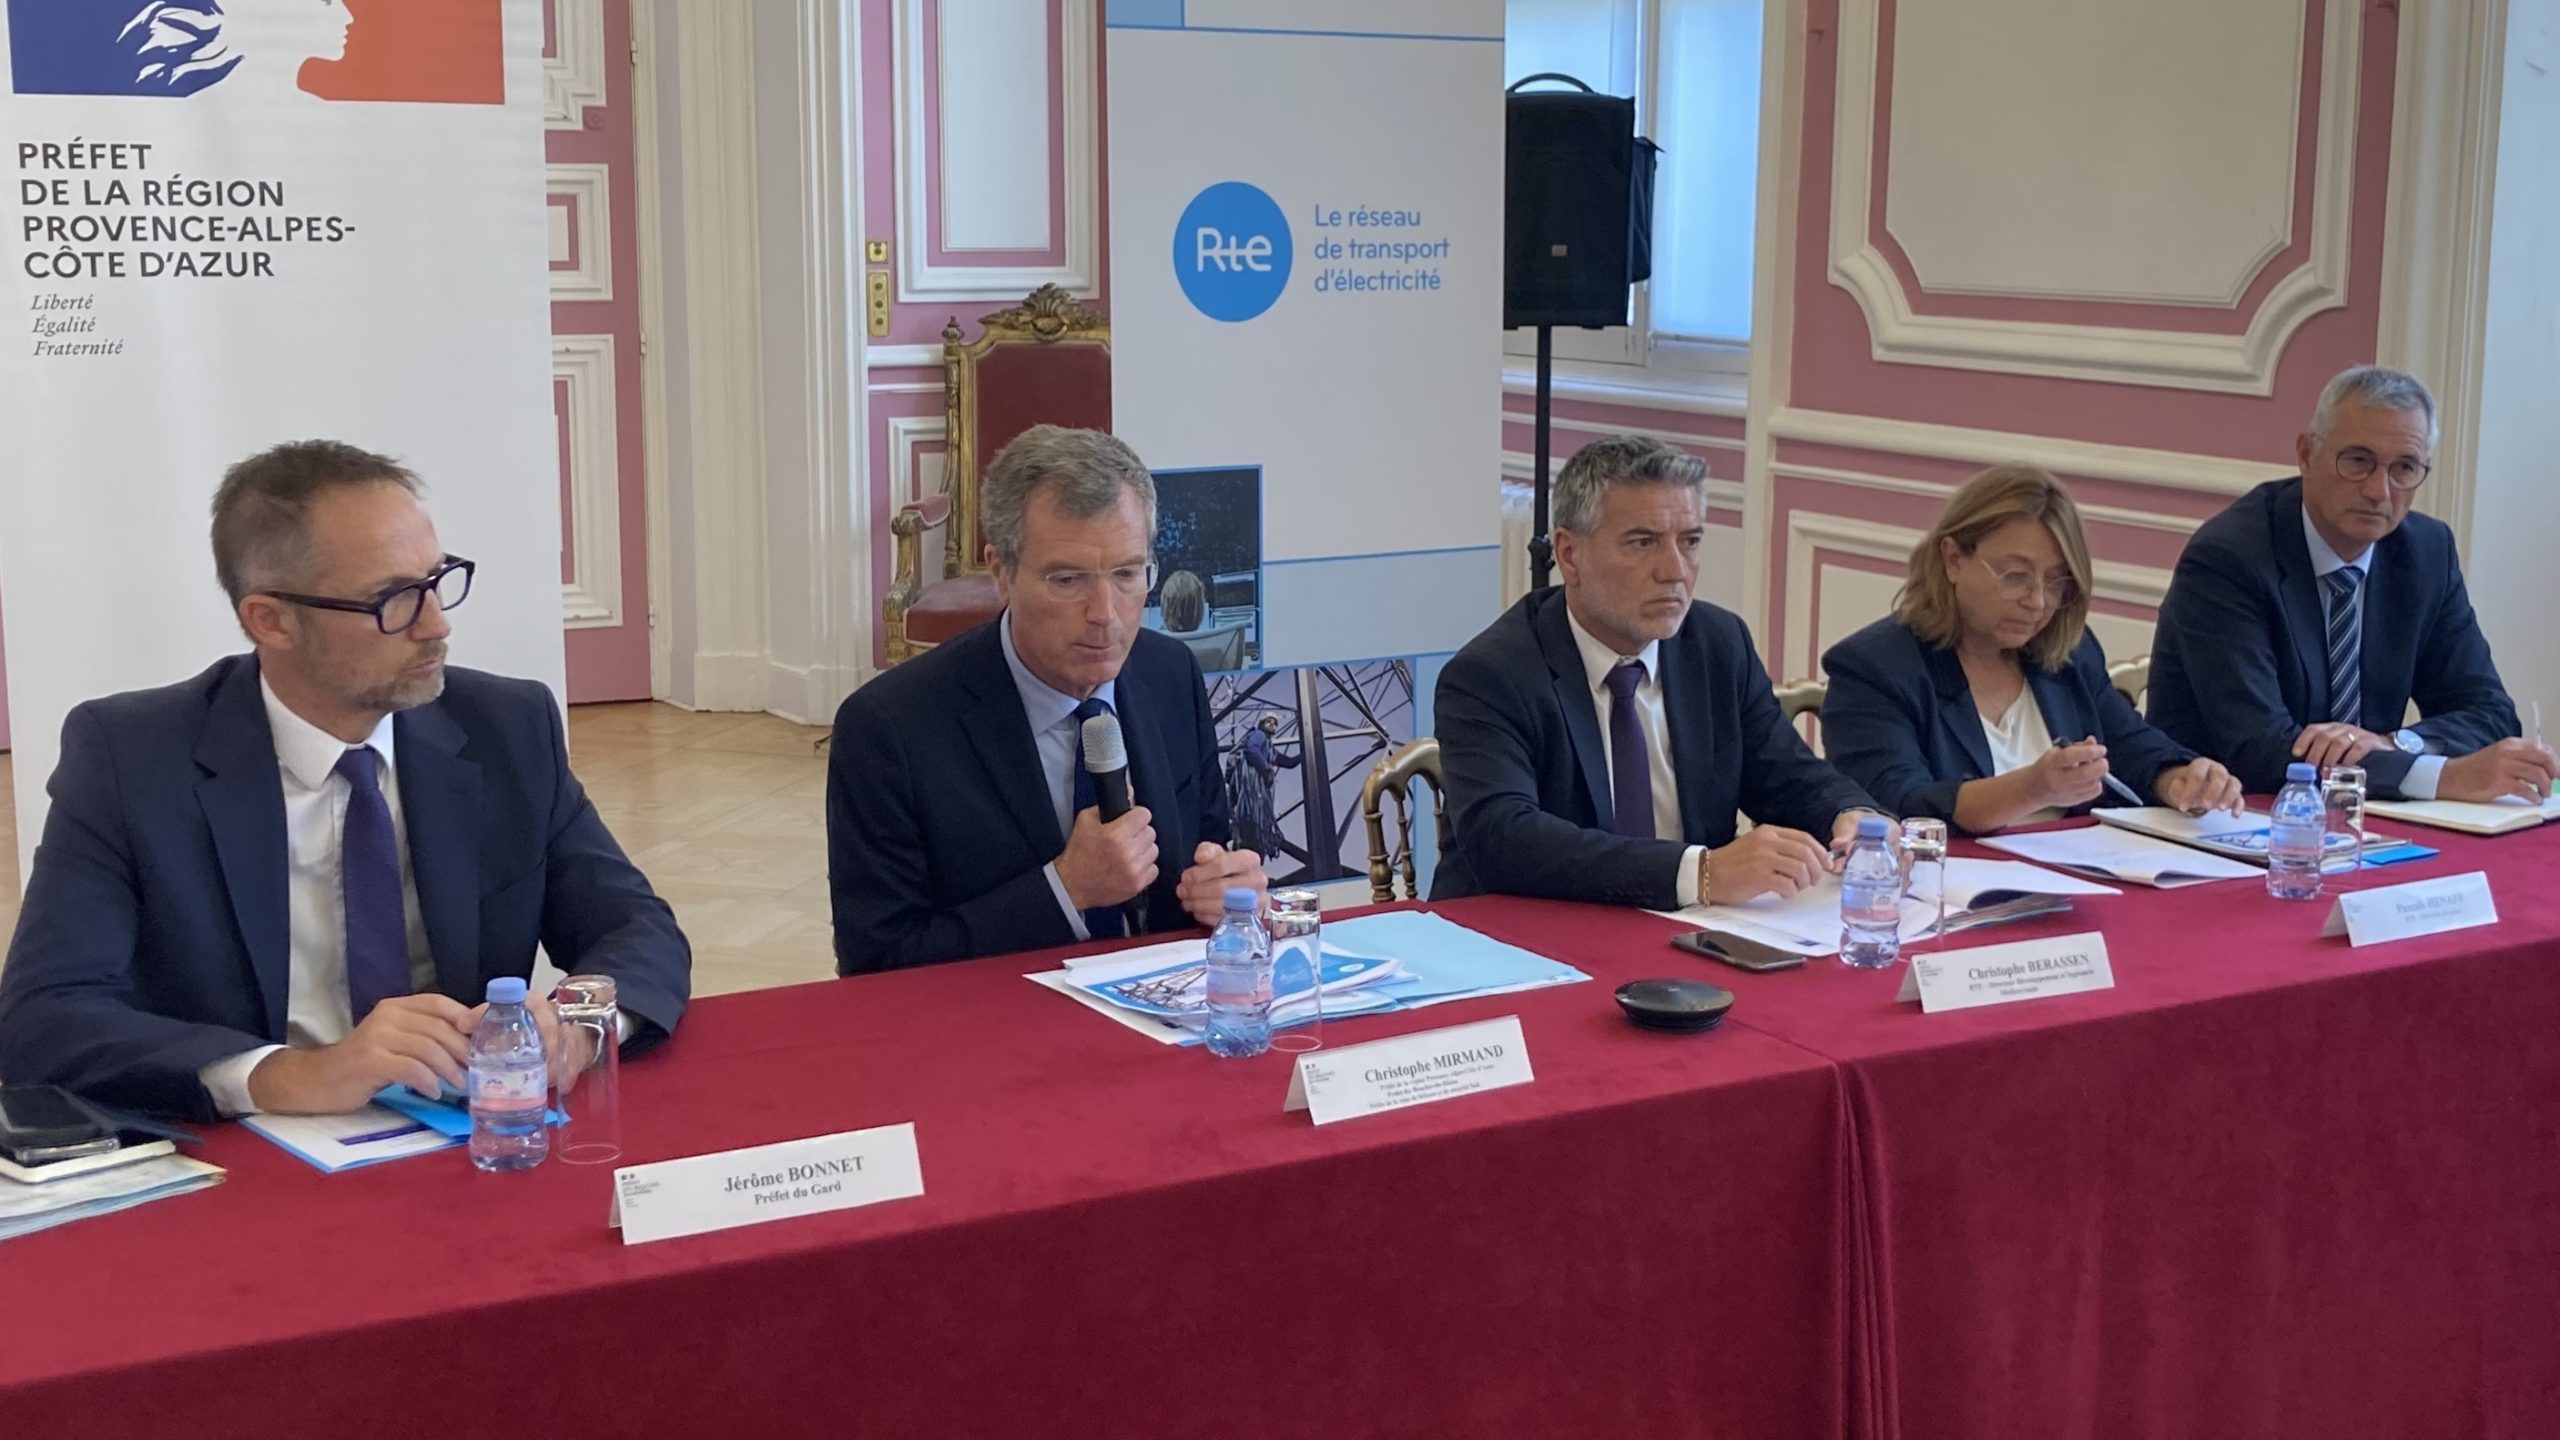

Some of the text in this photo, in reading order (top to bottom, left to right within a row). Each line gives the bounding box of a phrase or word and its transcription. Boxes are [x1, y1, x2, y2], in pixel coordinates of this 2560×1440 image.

[18, 136, 152, 170] PRÉFET
[20, 174, 284, 207] DE LA RÉGION
[23, 215, 355, 242] PROVENCE-ALPES-
[1315, 204, 1421, 227] Le réseau
[24, 245, 275, 278] CÔTE D'AZUR
[1314, 237, 1449, 263] de transport
[1315, 268, 1441, 291] d'électricité
[30, 294, 93, 310] Liberté
[32, 314, 96, 337] Égalité
[33, 339, 124, 356] Fraternité
[1968, 963, 2025, 979] Christophe
[1365, 1060, 1431, 1083] Christophe
[1433, 1044, 1504, 1069] MIRMAND
[724, 1155, 865, 1193] Jérôme BONNET
[754, 1180, 842, 1206] Préfet du Gard
